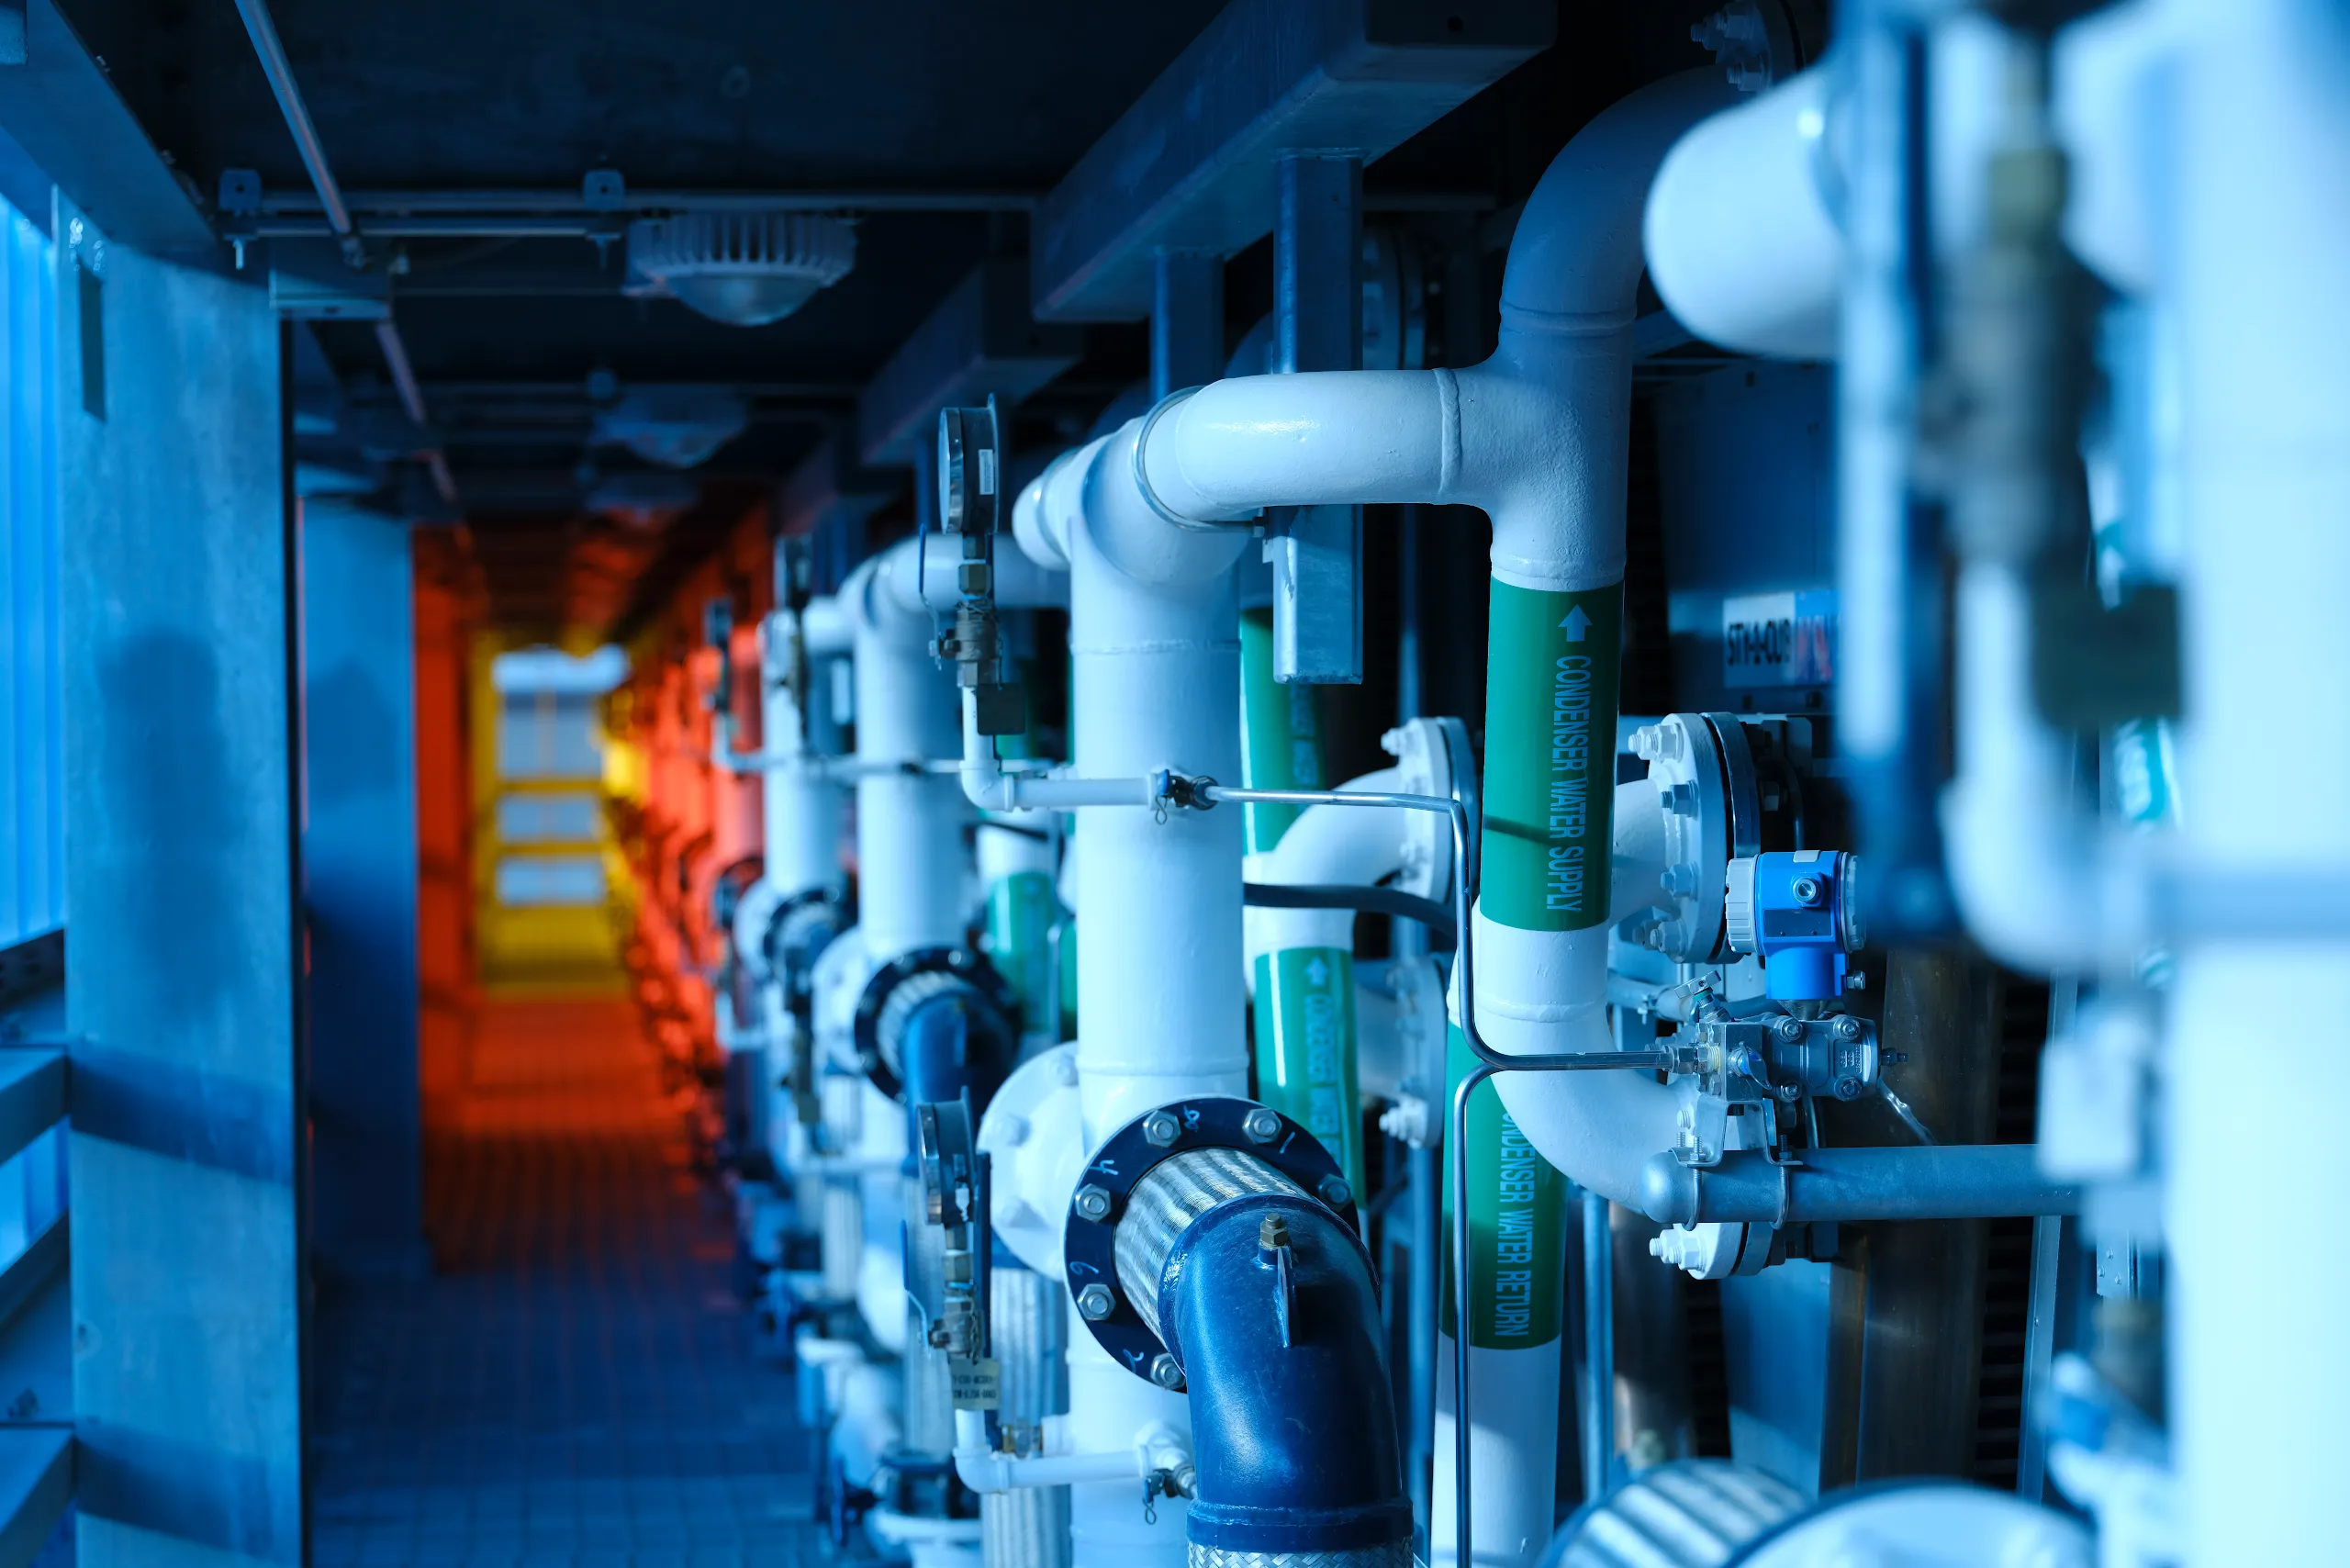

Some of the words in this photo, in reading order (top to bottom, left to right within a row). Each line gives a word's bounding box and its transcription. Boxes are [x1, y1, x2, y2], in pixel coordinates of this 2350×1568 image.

[1551, 655, 1593, 771] CONDENSER
[1549, 777, 1588, 839] WATER
[1546, 846, 1585, 913] SUPPLY
[1499, 1112, 1536, 1203] NDENSER
[1497, 1207, 1534, 1264] WATER
[1494, 1269, 1532, 1337] RETURN
